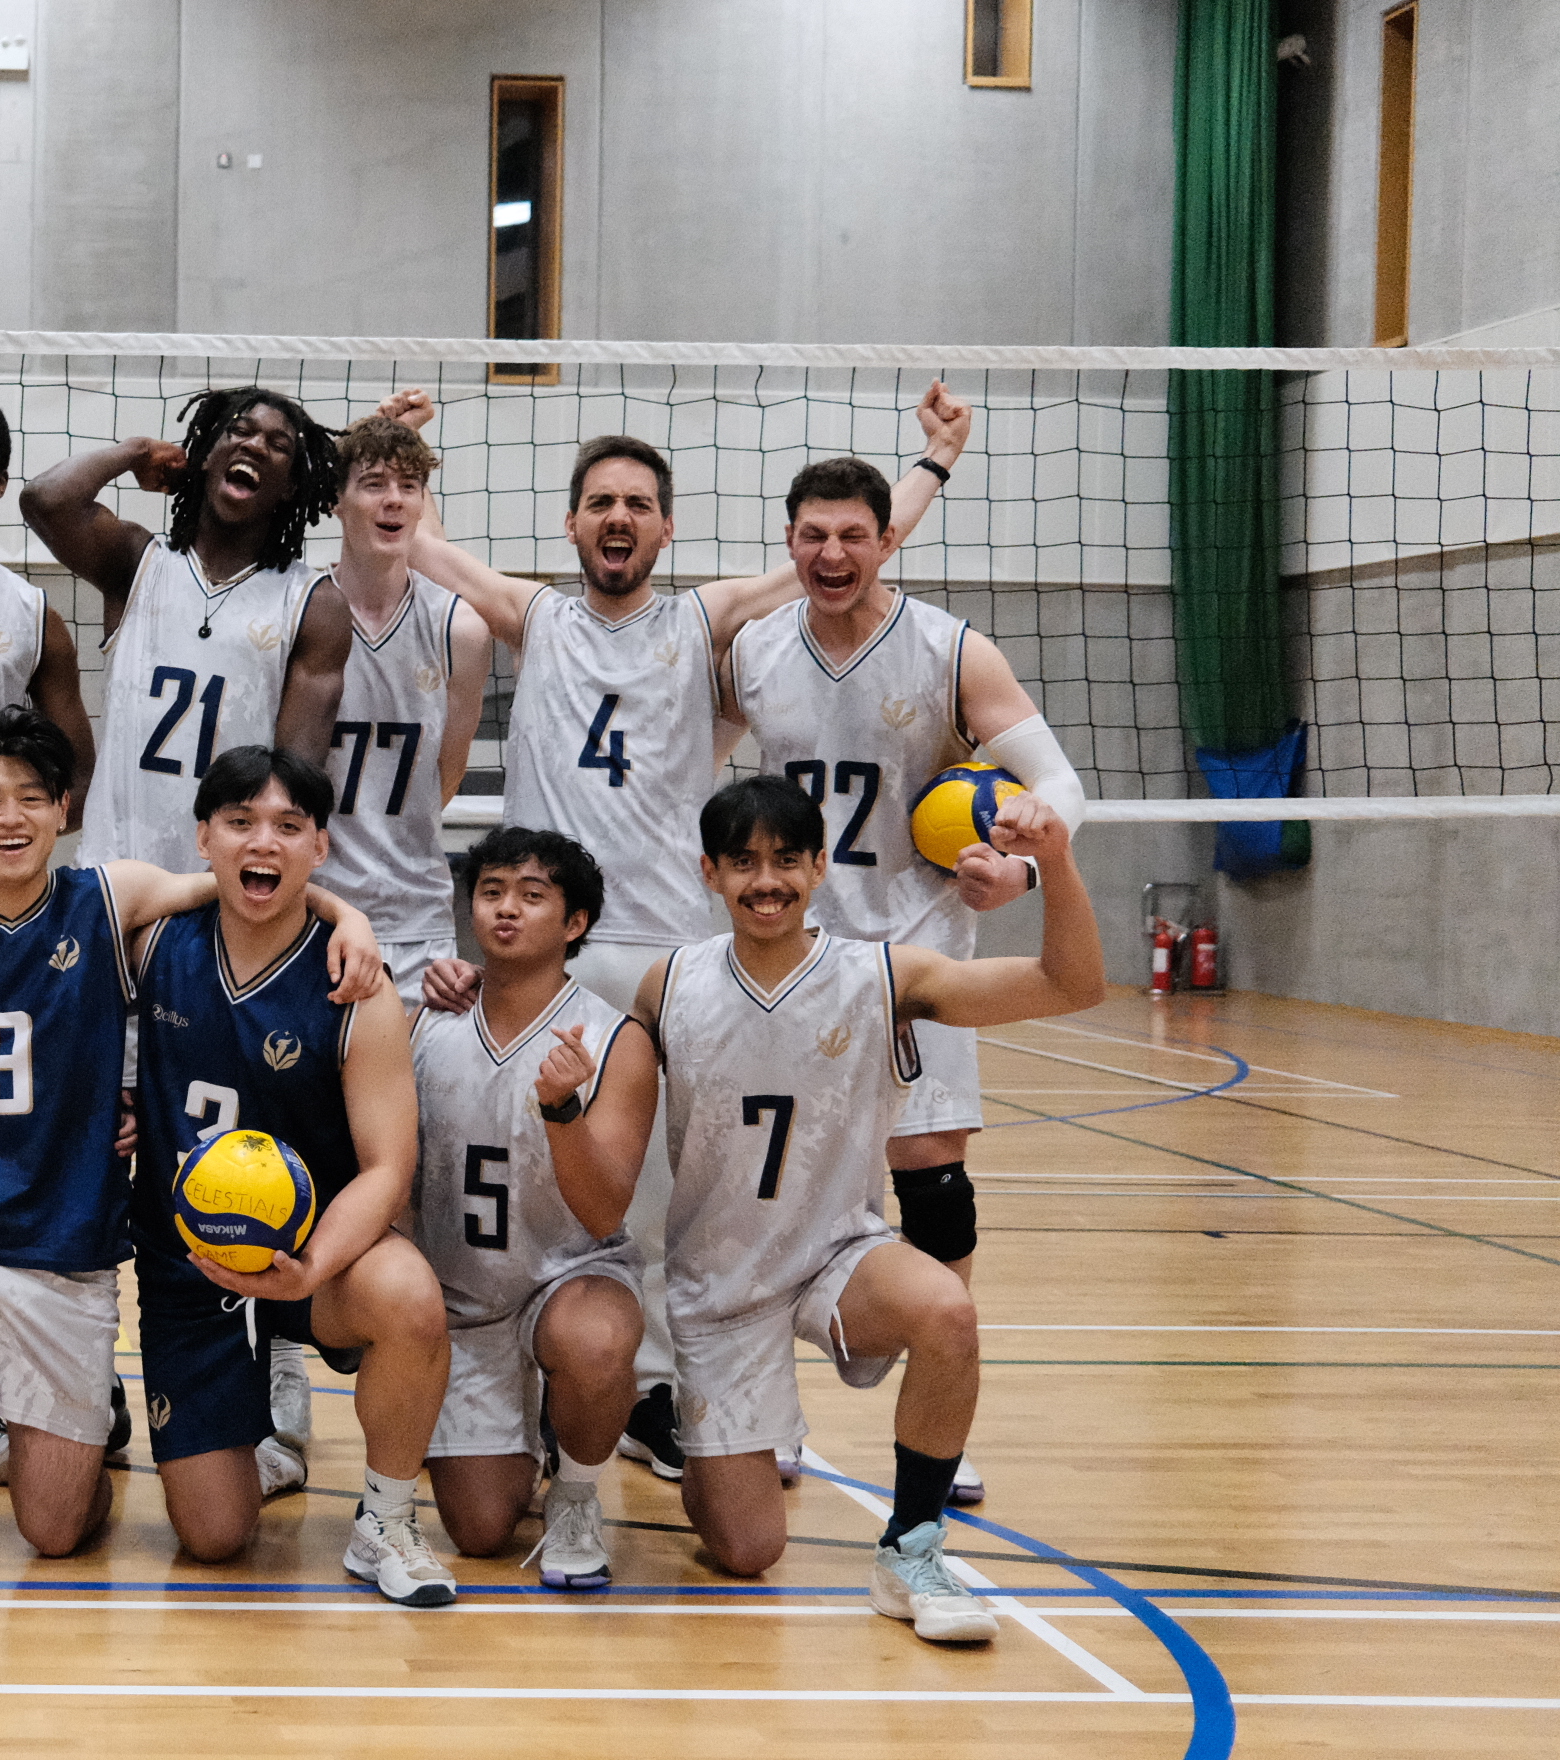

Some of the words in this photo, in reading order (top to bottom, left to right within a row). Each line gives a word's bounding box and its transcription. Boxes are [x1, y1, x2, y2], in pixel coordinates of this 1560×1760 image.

[139, 666, 225, 779] 21
[330, 721, 422, 816] 77
[577, 694, 631, 787] 4
[464, 1145, 509, 1250] 5
[742, 1095, 796, 1200] 7
[186, 1178, 288, 1222] CELESTIALS
